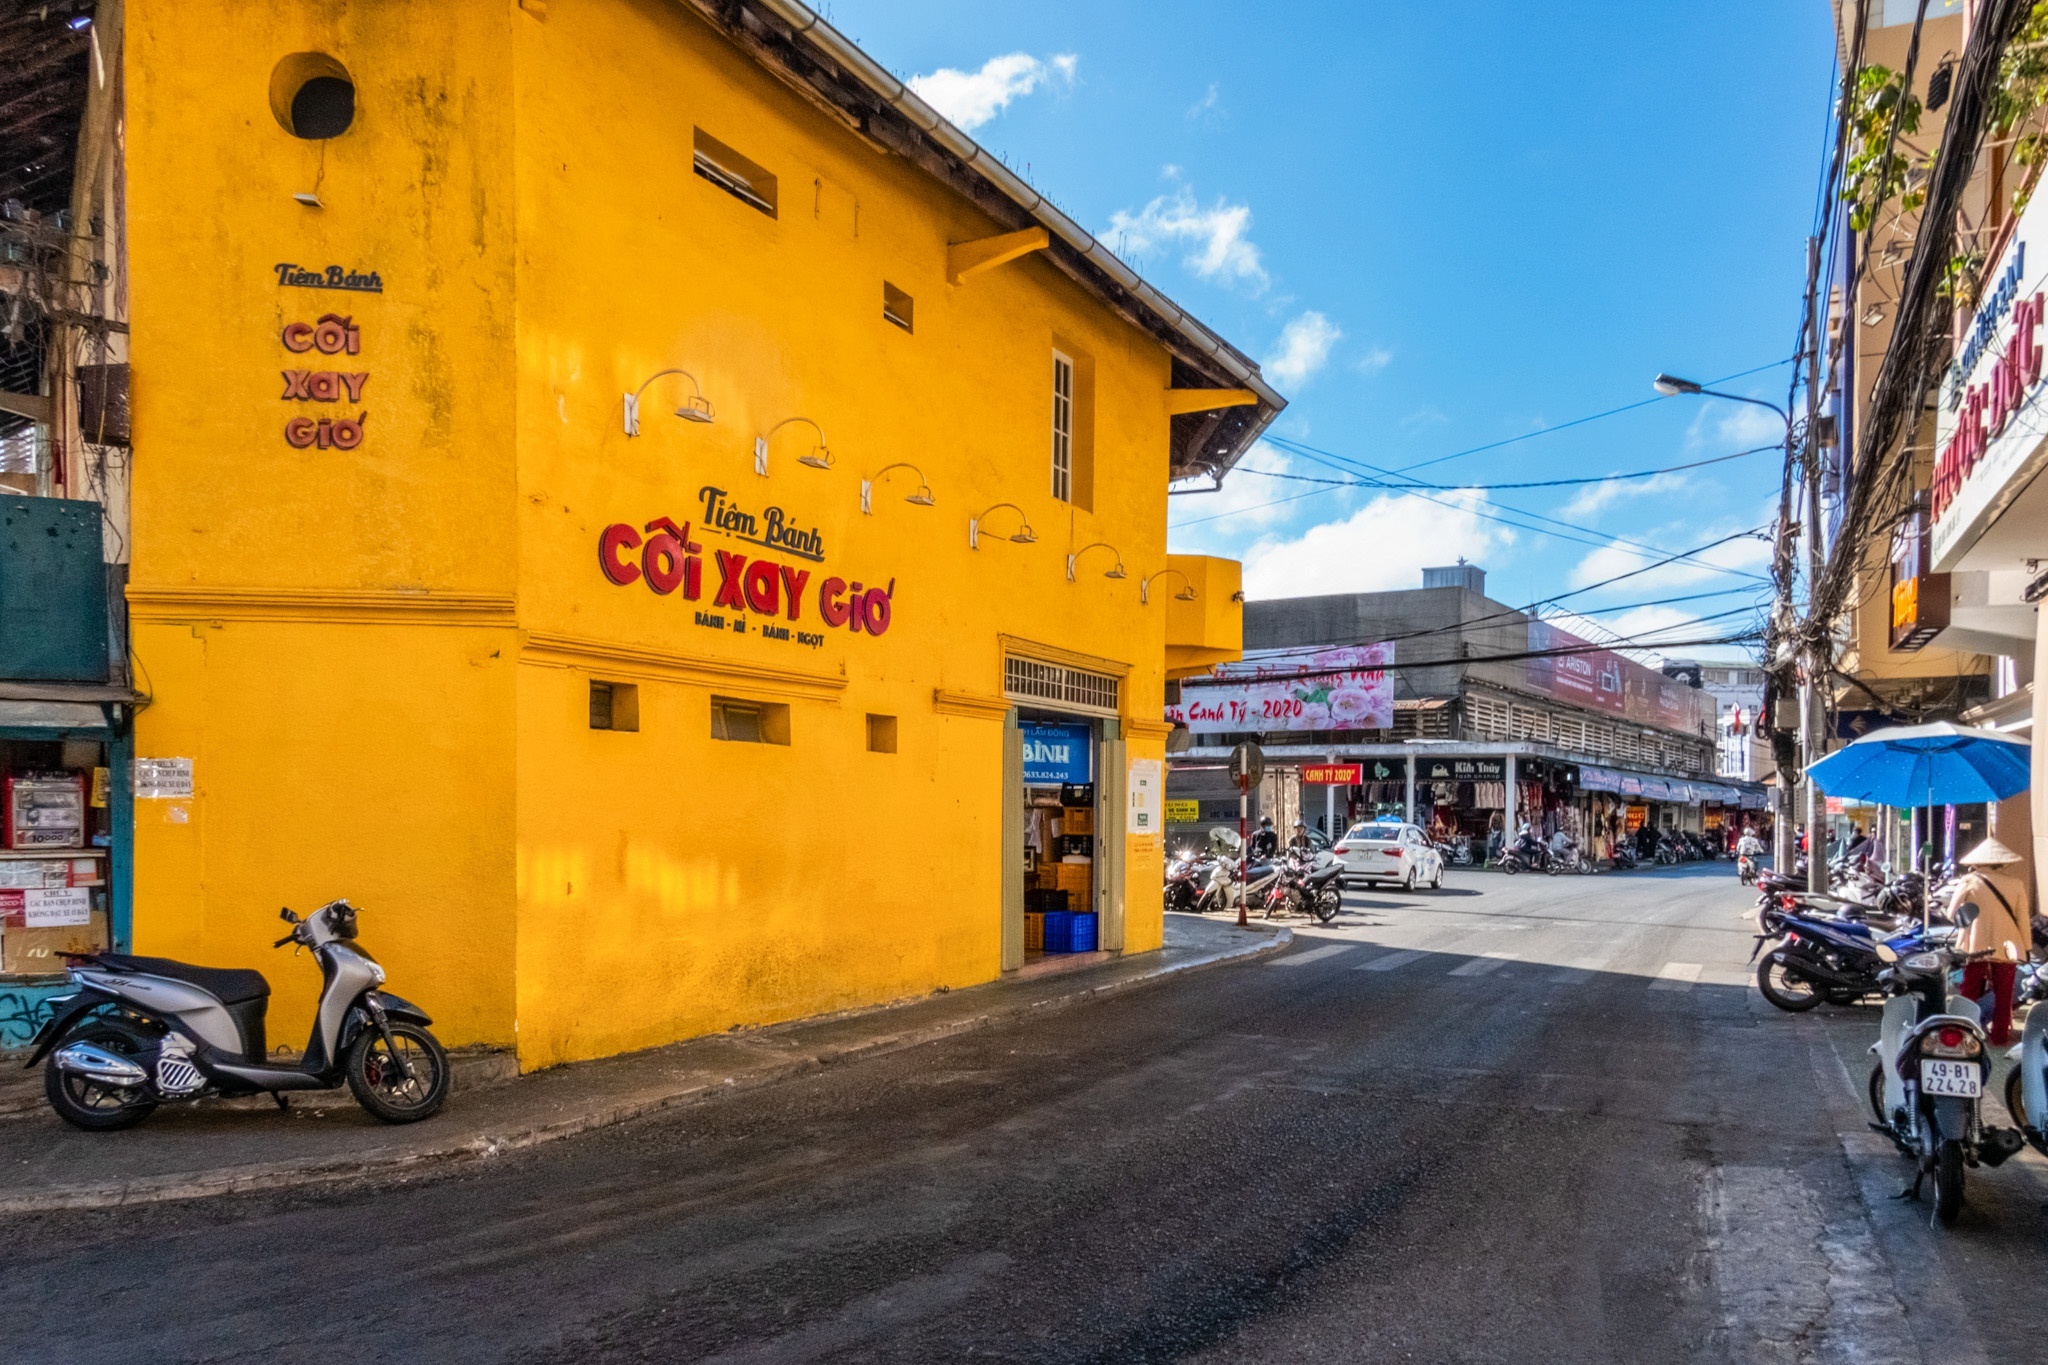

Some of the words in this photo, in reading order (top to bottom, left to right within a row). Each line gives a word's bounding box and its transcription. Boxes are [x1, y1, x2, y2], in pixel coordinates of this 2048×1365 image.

[325, 264, 384, 290] Bánh
[698, 485, 758, 538] Tiệm
[763, 506, 825, 557] Bánh
[694, 610, 724, 630] BÁNH
[762, 622, 789, 642] BÁNH
[797, 633, 825, 650] NGỌT
[1565, 656, 1592, 677] ARISTON
[1188, 700, 1225, 722] Canh
[1262, 699, 1304, 719] 2020
[1305, 769, 1324, 782] CANH
[1931, 1062, 1970, 1079] 49-B1
[1926, 1077, 1977, 1095] 224.28
